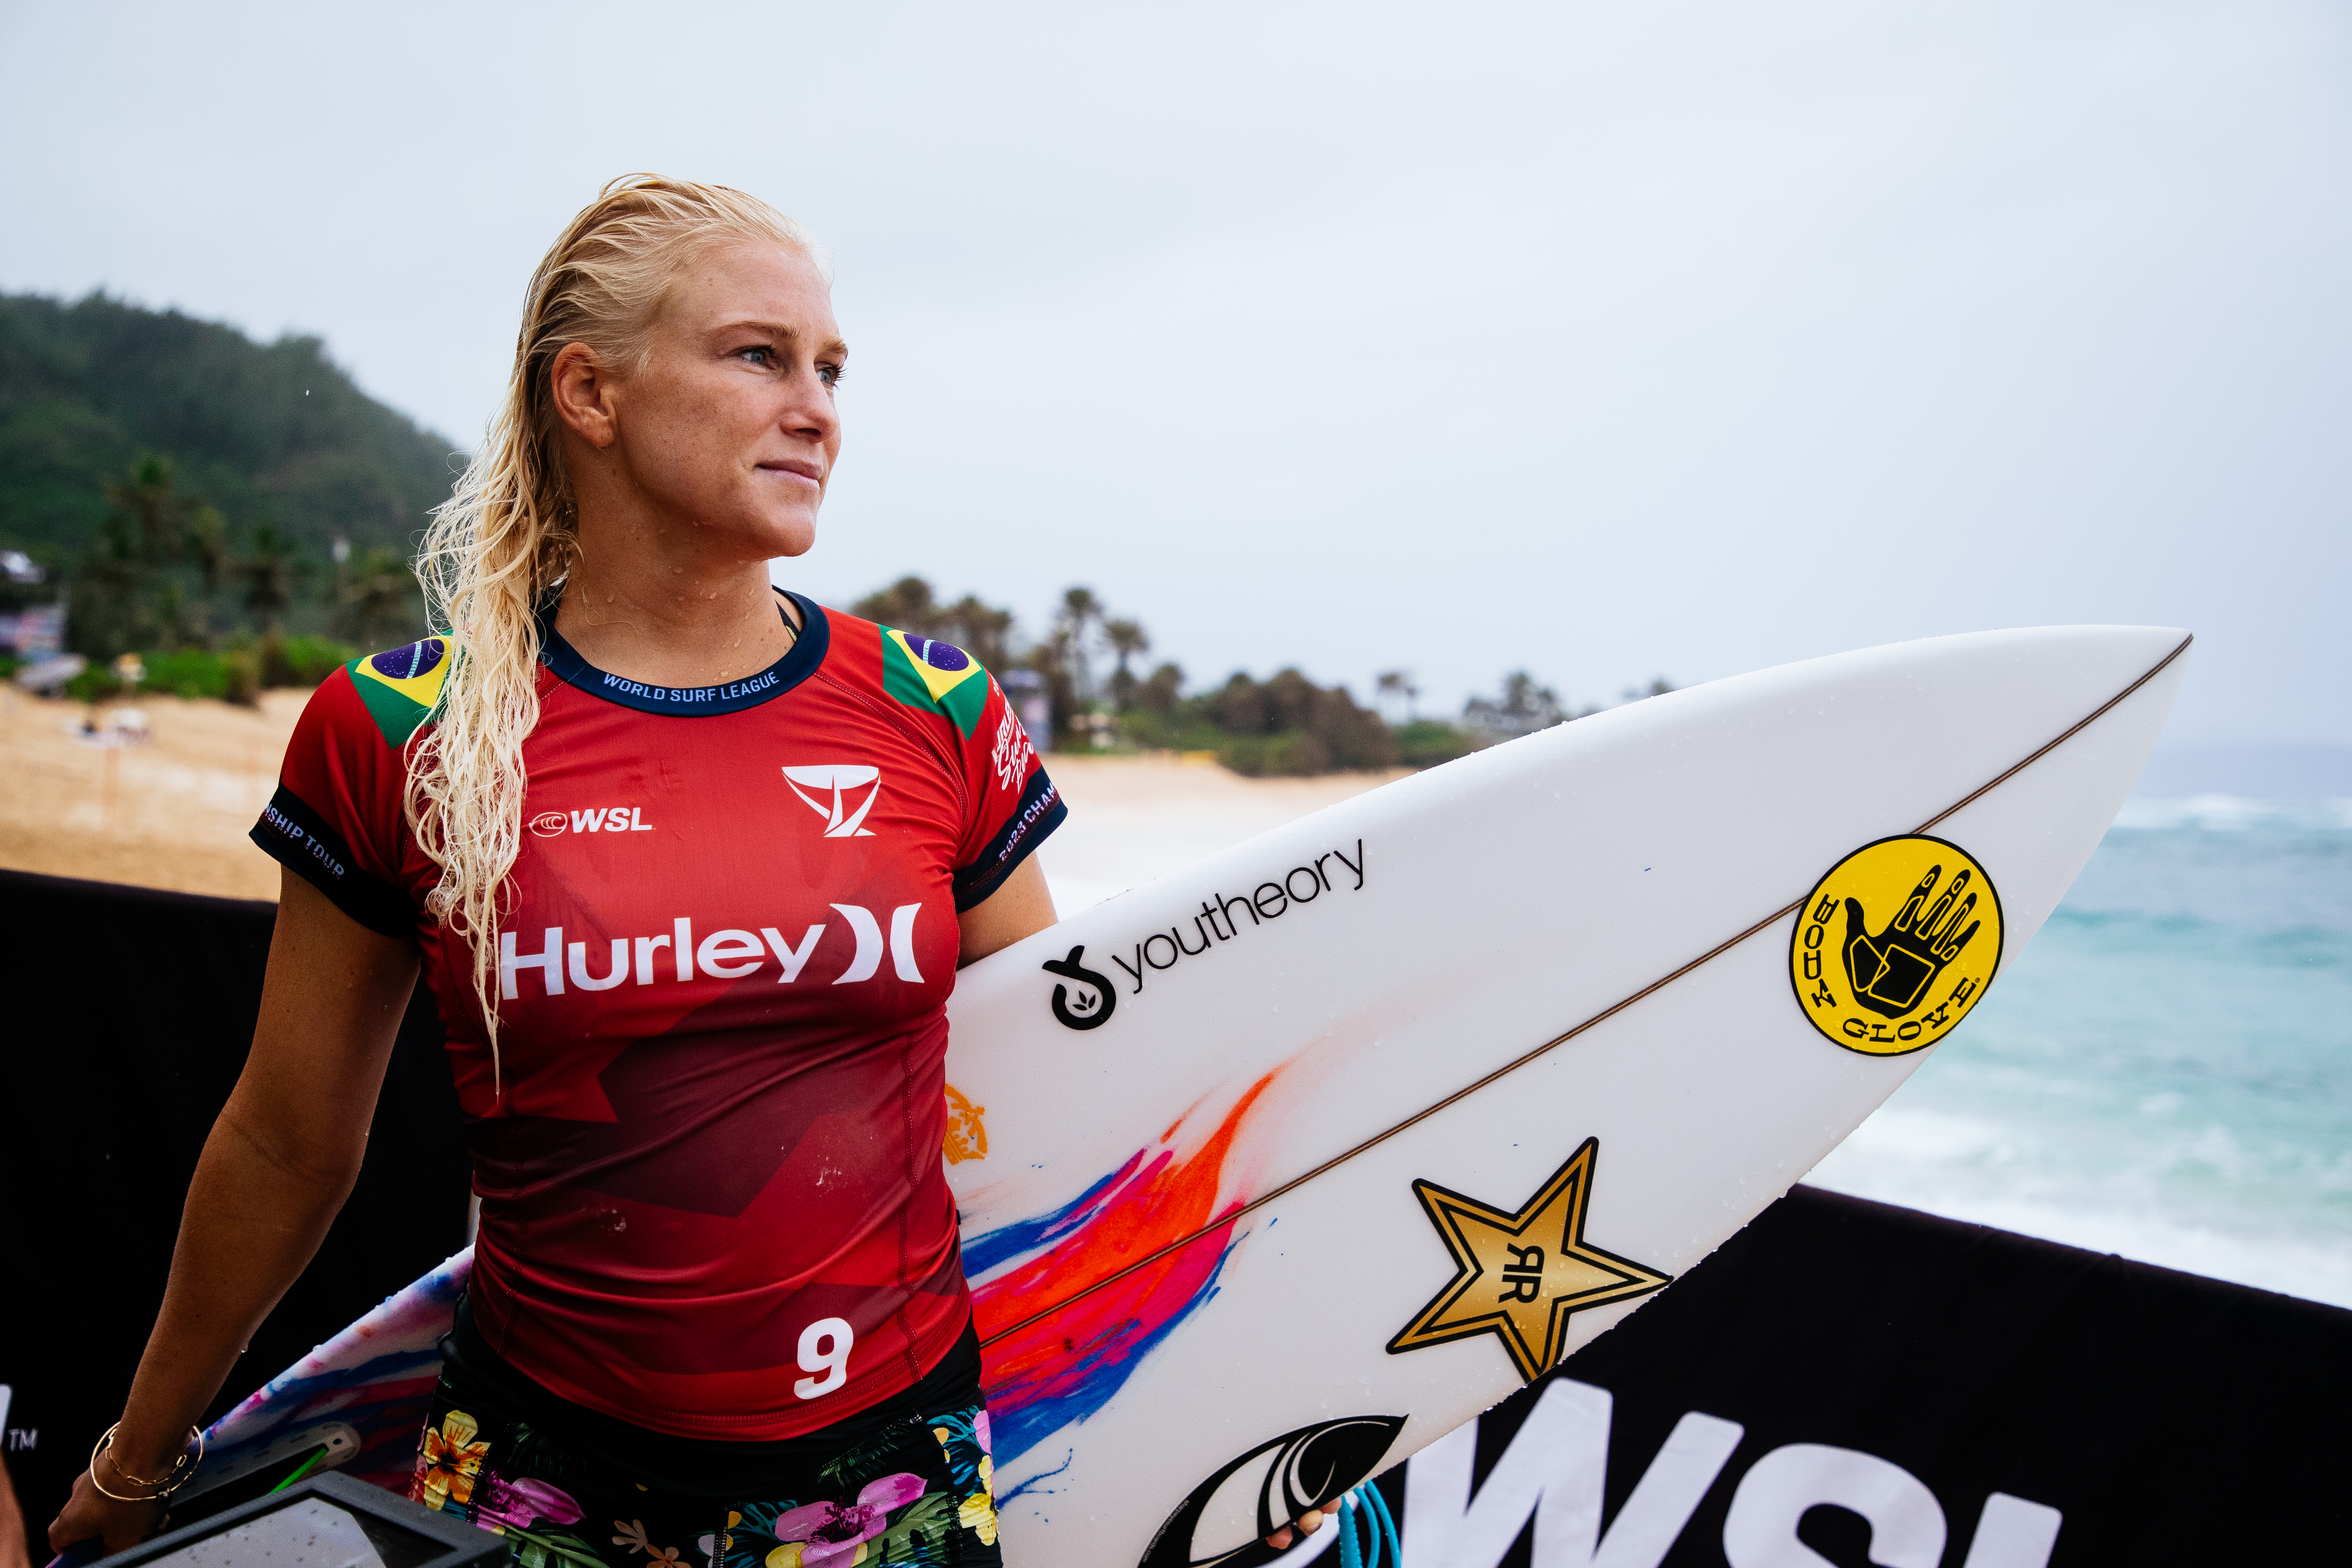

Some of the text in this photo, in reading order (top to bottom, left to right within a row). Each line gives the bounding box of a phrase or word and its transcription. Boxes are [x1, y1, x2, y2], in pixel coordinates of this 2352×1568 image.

[409, 649, 421, 676] PROGRESSO
[603, 671, 779, 702] WORLD SURF LEAGUE
[571, 807, 653, 833] WSL
[304, 835, 345, 880] TOUR
[1111, 838, 1364, 995] youtheory
[500, 917, 826, 1000] Hurley
[1803, 893, 1840, 1008] BODY
[794, 1317, 854, 1400] 9
[8, 1426, 38, 1451] TM
